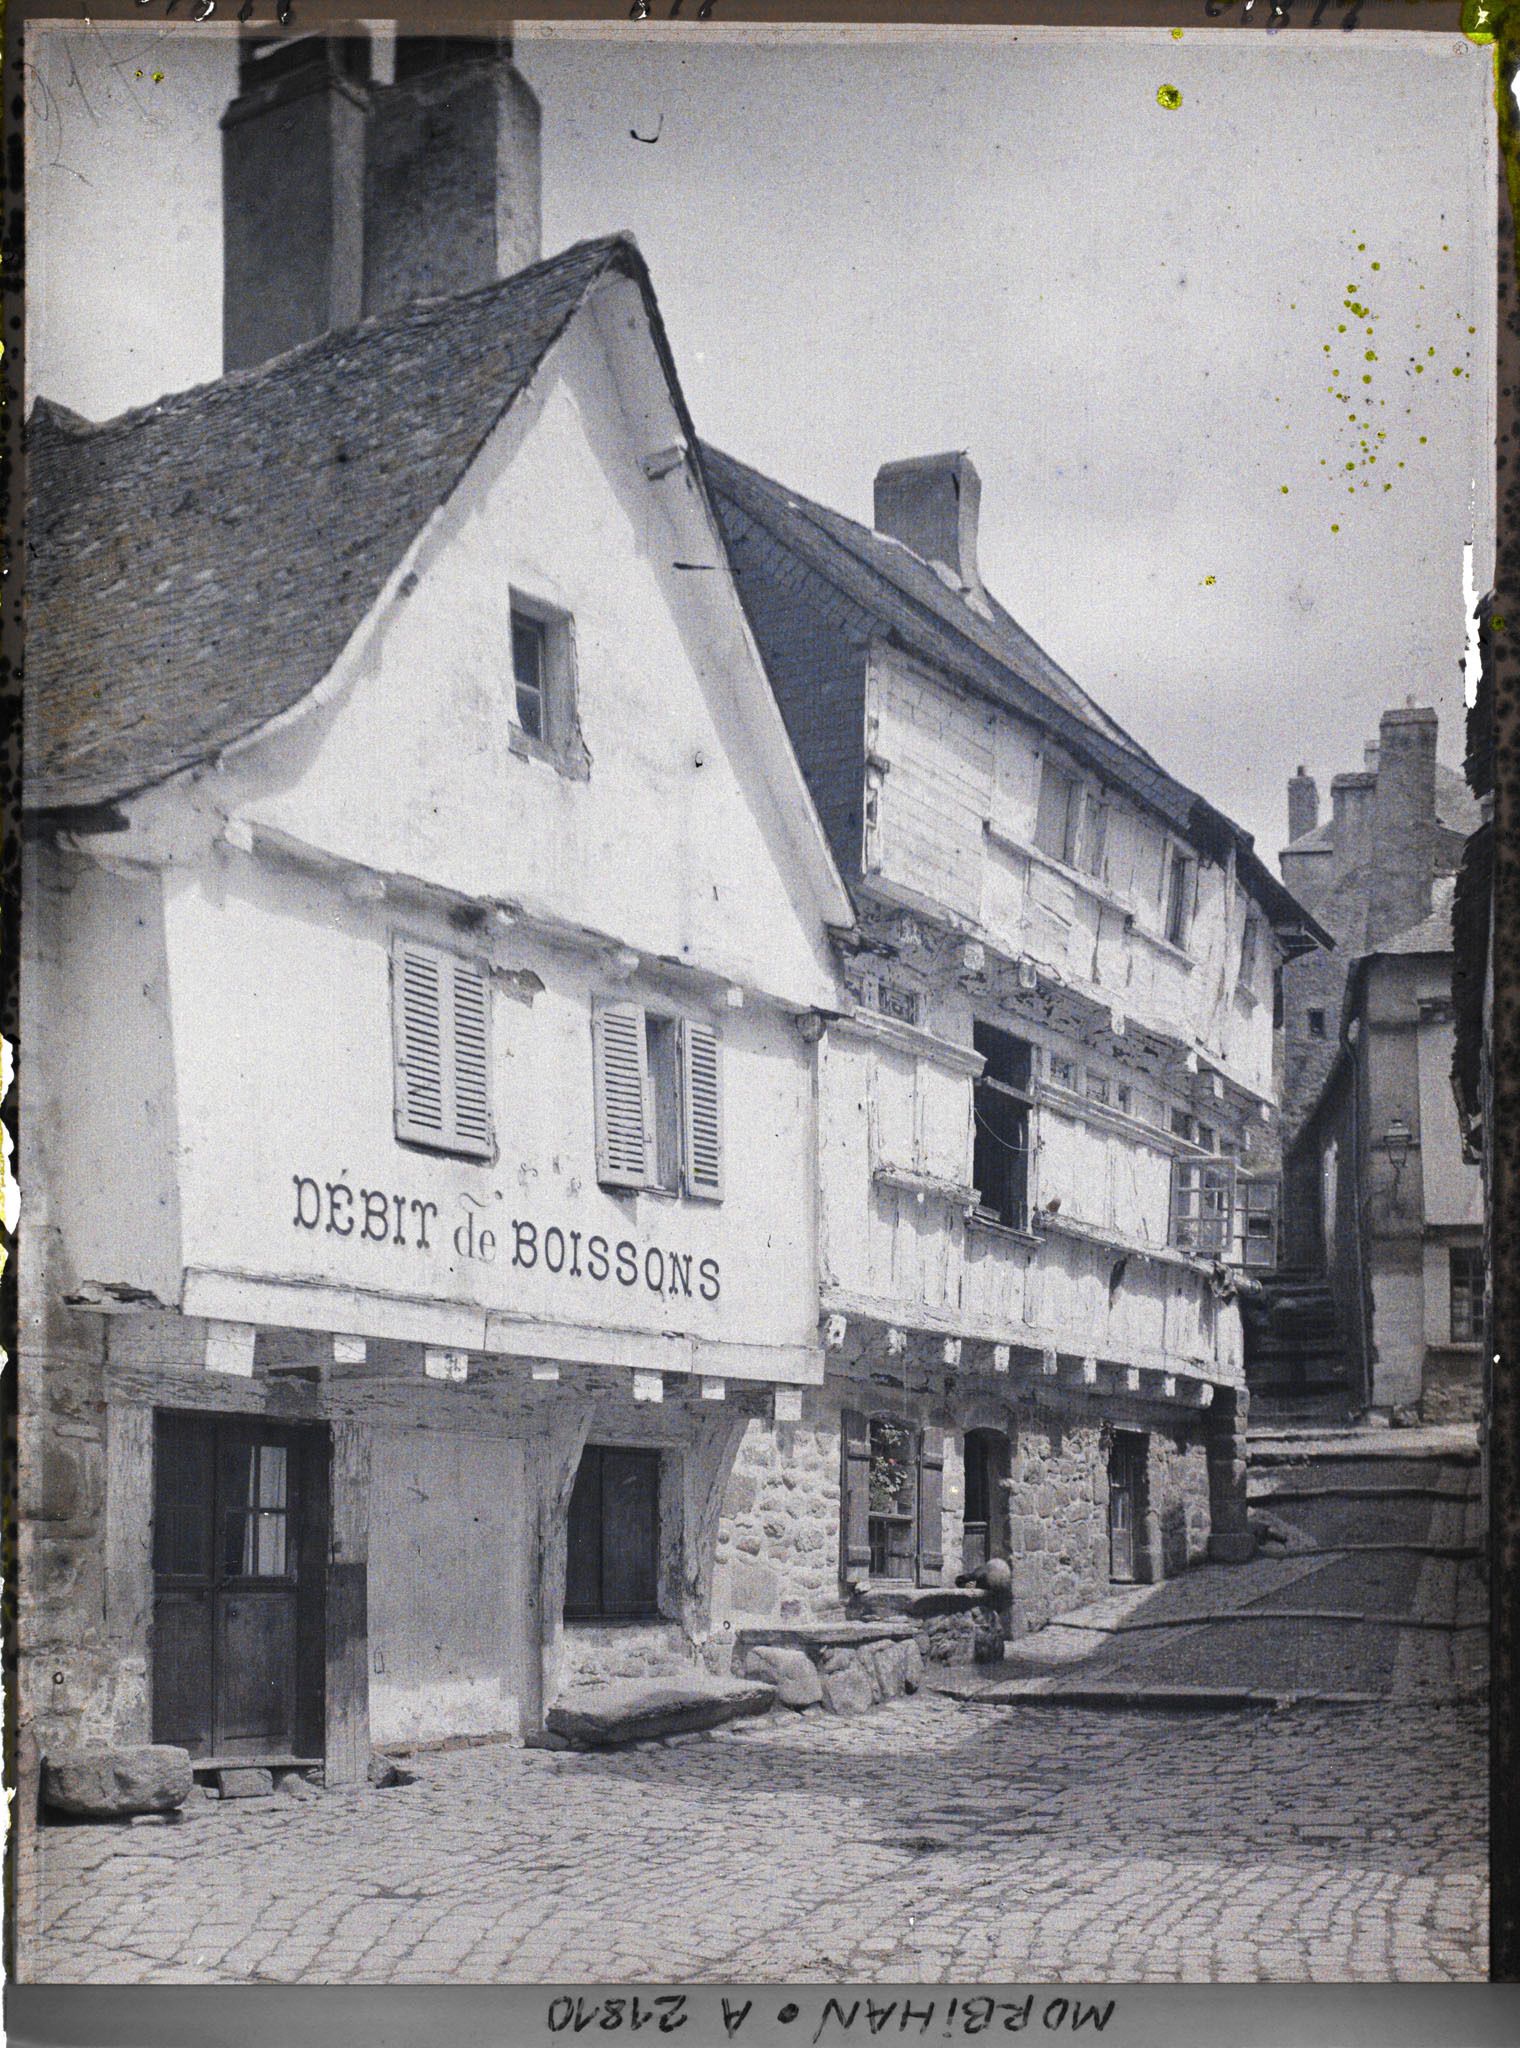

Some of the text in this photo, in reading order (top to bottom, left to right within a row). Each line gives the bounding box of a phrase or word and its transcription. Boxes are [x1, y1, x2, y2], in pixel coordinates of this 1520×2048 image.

[292, 1168, 438, 1249] DÉBIT
[453, 1209, 497, 1264] de
[511, 1218, 721, 1301] BOISSONS
[548, 1995, 687, 2033] 21810
[720, 1997, 752, 2039] A
